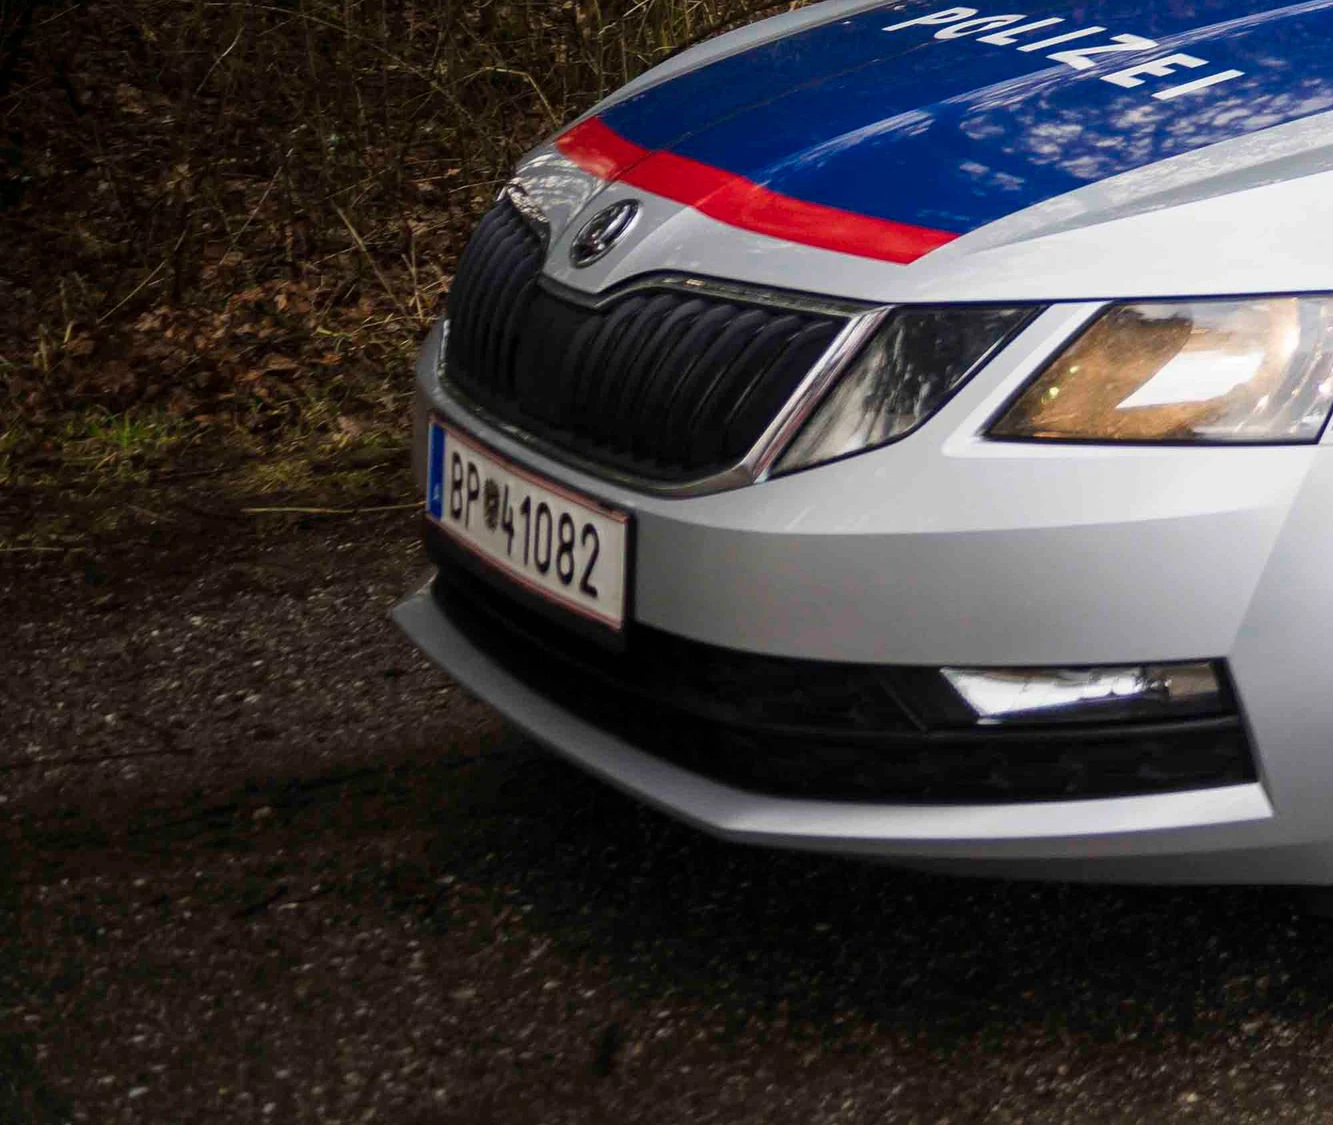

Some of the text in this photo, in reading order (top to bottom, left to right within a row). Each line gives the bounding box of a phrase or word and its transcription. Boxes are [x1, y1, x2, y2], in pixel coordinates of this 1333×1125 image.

[882, 6, 1244, 100] POLIZEI
[450, 452, 599, 598] BP 41082
